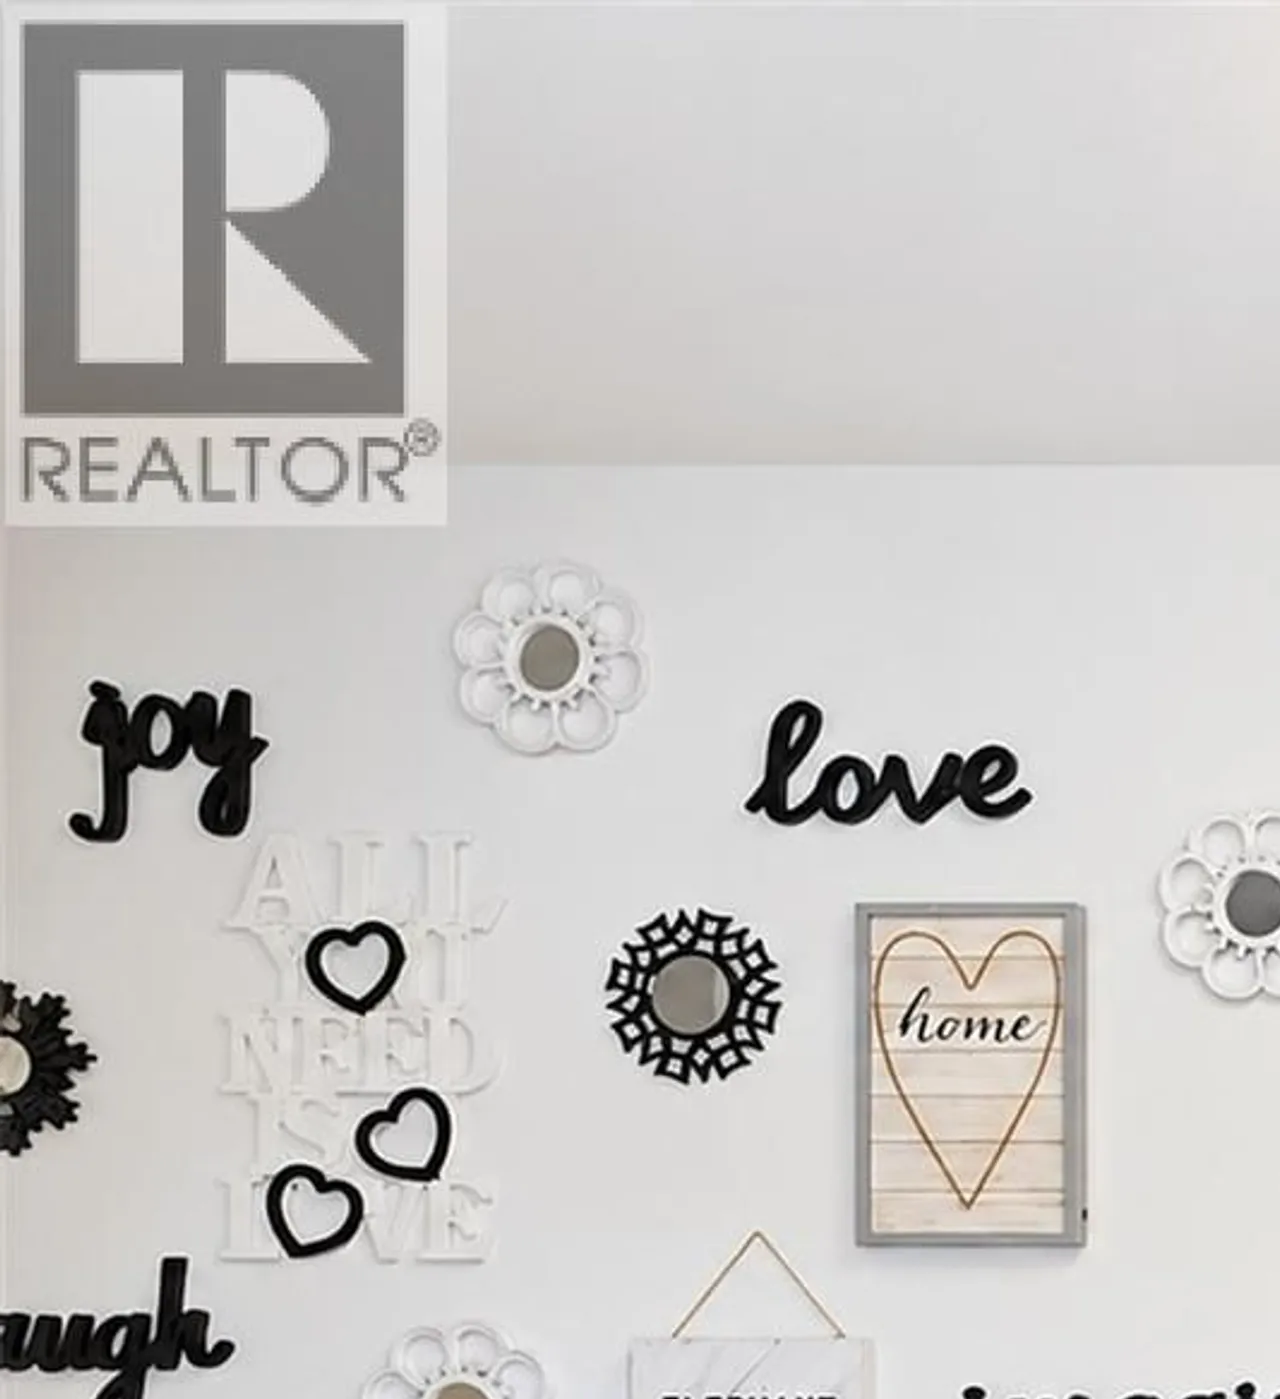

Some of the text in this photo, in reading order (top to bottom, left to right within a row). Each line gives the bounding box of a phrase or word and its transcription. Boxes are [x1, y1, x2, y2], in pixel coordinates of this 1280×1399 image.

[69, 681, 269, 842] joy
[745, 700, 1032, 826] love
[218, 830, 510, 934] ALL
[243, 924, 477, 1010] YU
[217, 1010, 504, 1096] NEED
[900, 985, 1049, 1044] home
[246, 1096, 350, 1174] IS
[217, 1177, 496, 1265] LVE
